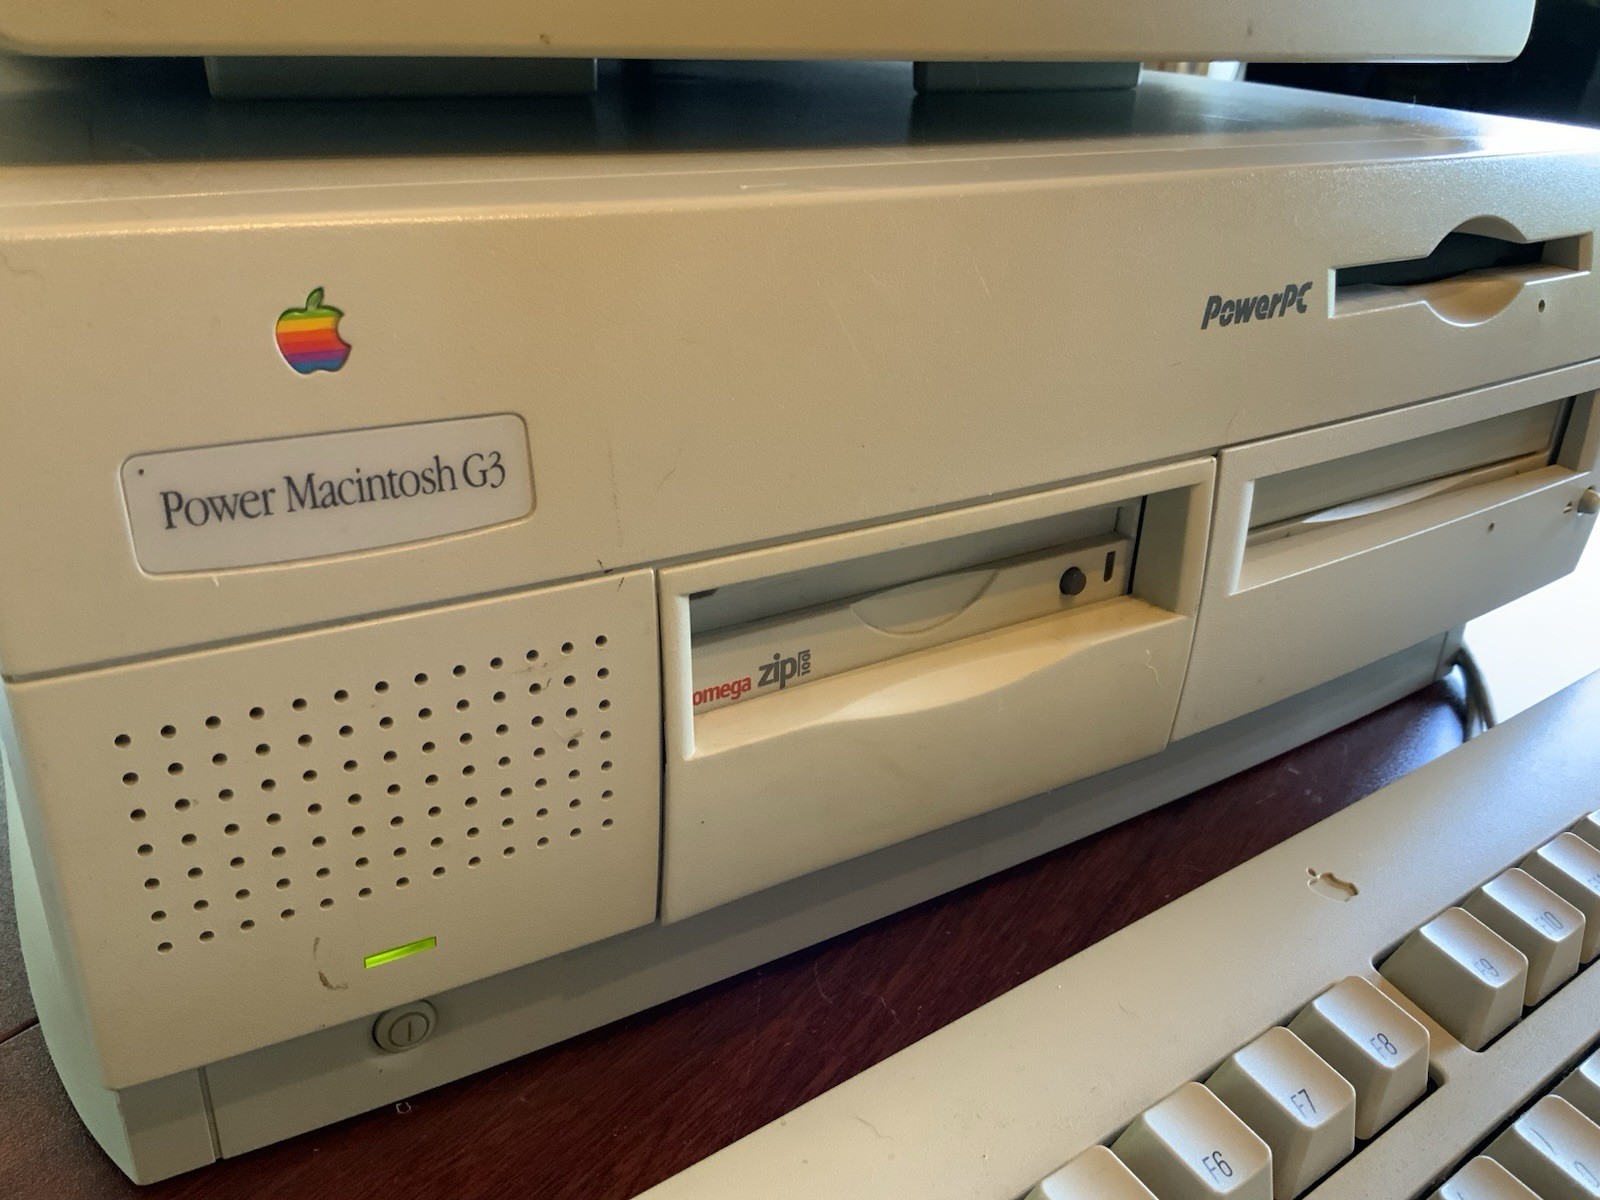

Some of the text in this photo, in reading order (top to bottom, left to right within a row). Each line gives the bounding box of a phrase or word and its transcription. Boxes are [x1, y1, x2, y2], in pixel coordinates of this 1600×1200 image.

[1200, 281, 1314, 330] PowerPC
[160, 450, 506, 530] Power Macintosh G3
[757, 652, 798, 690] zip
[1370, 1033, 1398, 1060] F8
[1290, 1088, 1317, 1118] F7
[1202, 1151, 1233, 1183] F6
